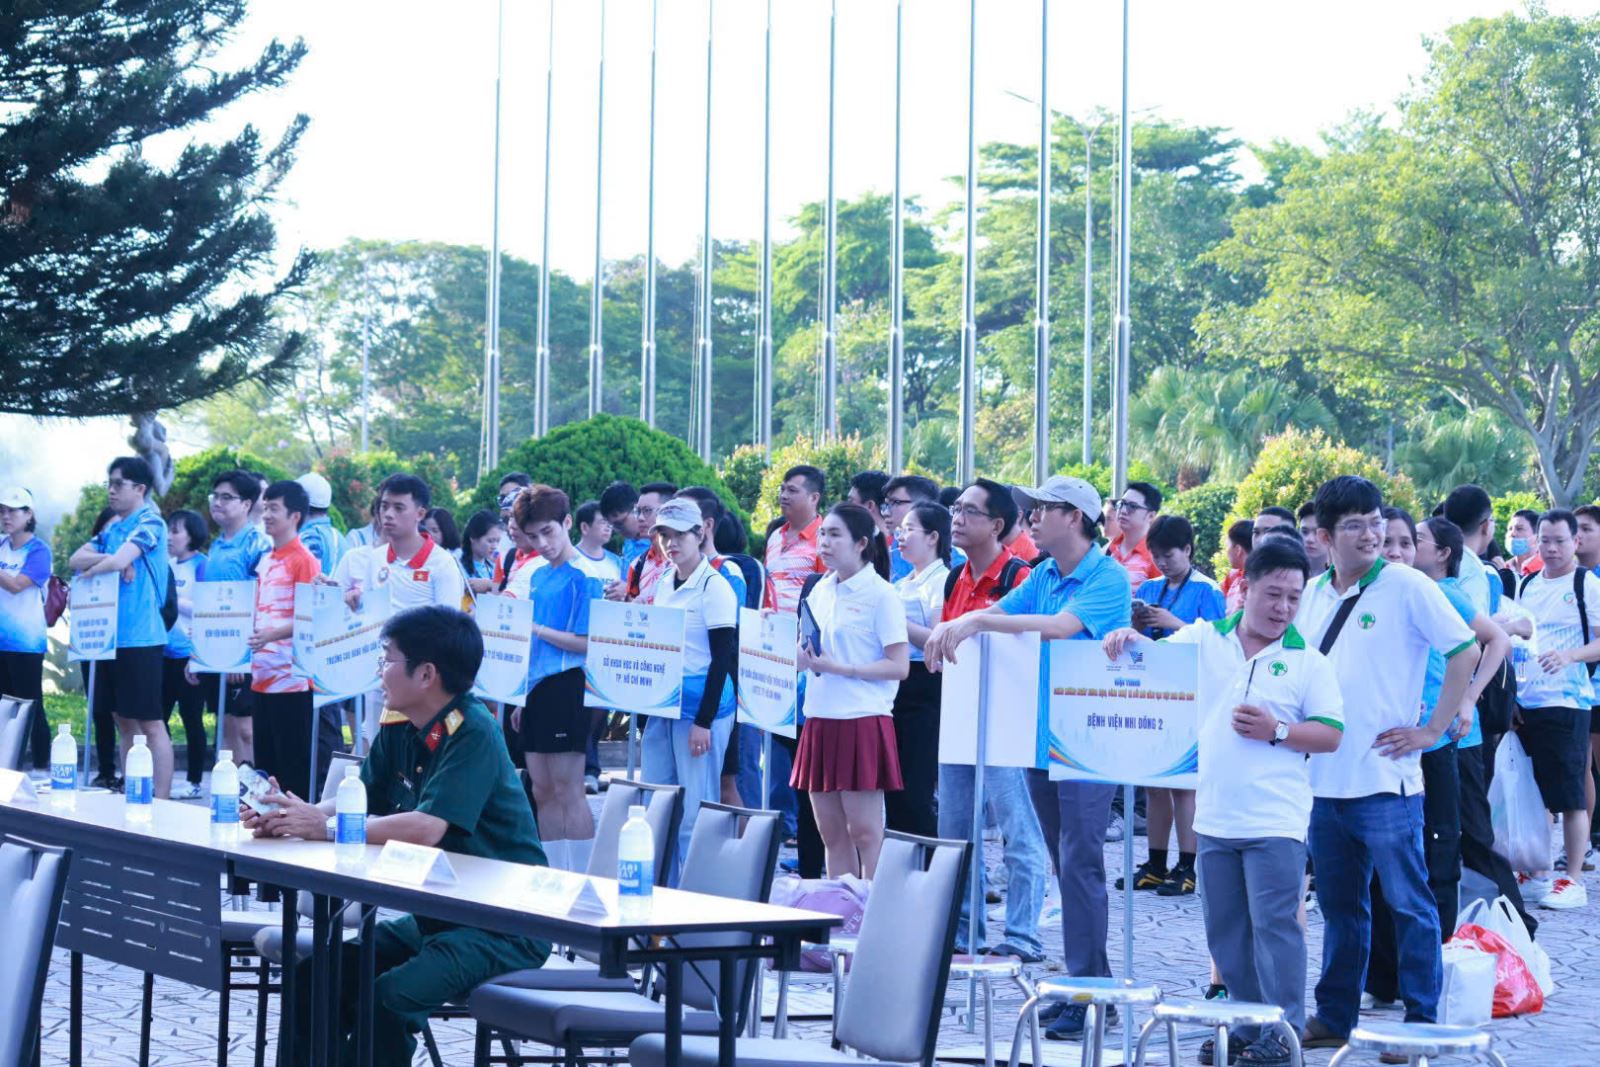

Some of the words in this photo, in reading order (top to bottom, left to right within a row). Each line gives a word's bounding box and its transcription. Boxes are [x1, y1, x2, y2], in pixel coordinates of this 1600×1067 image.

[1087, 712, 1106, 730] BỆNH
[1108, 713, 1123, 731] VIỆN
[1125, 716, 1137, 729] NHI
[1158, 719, 1164, 730] 2
